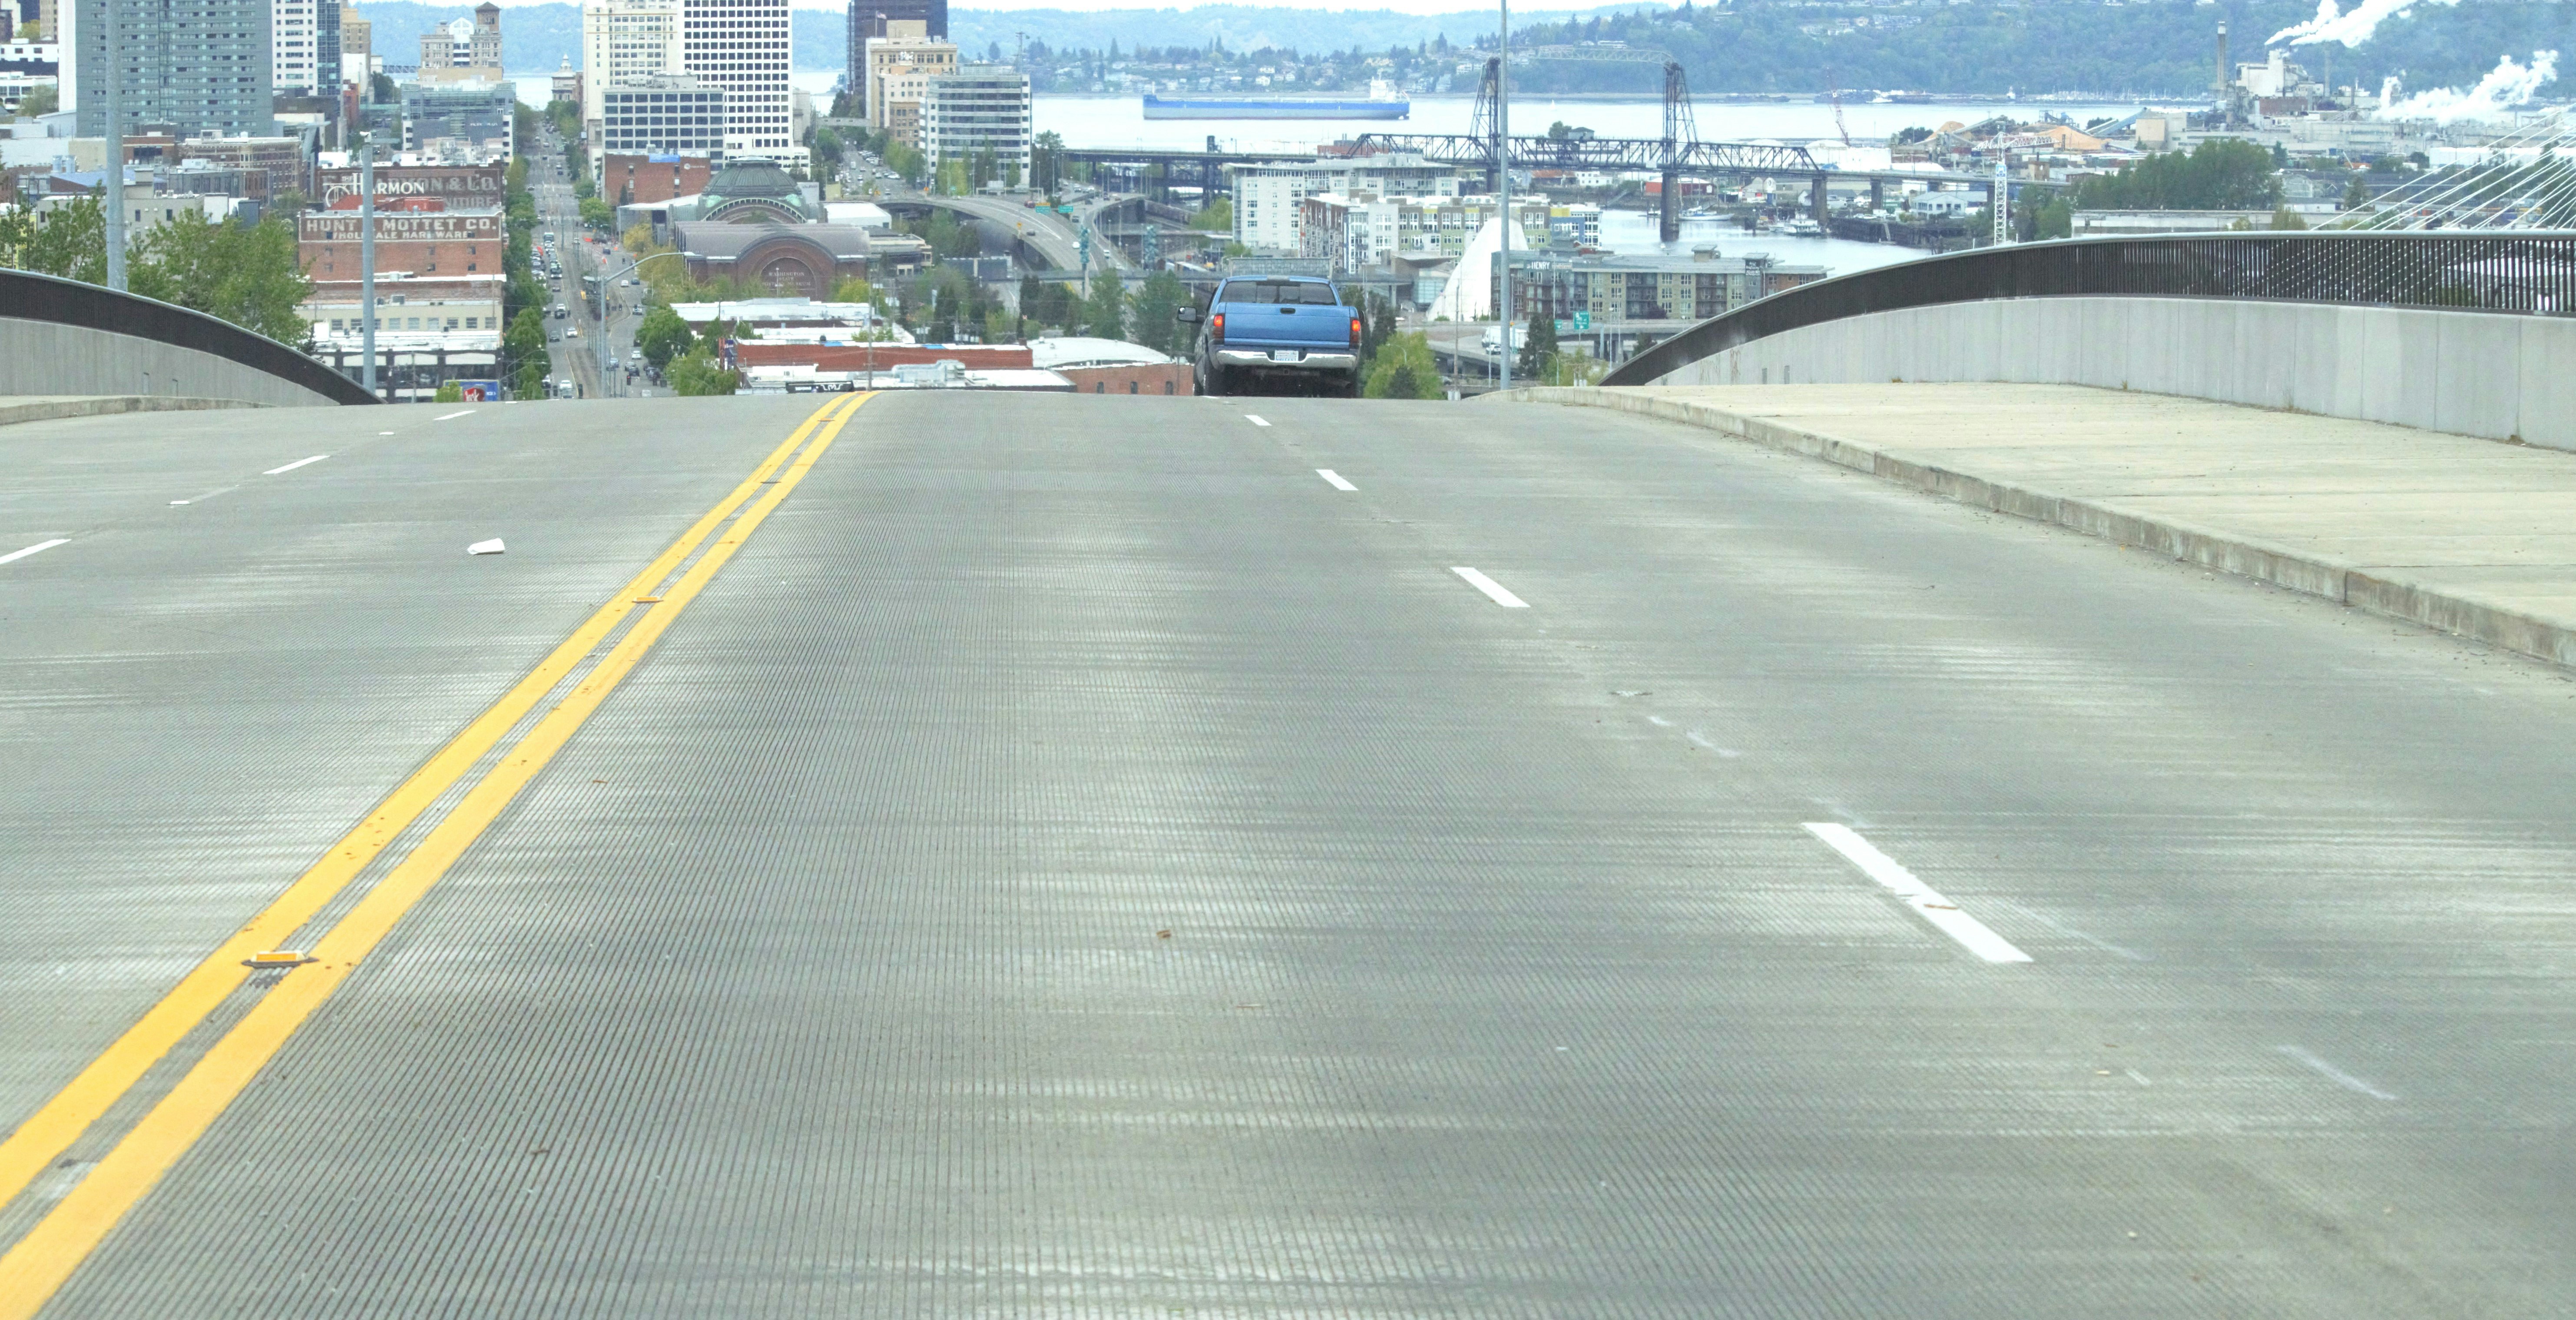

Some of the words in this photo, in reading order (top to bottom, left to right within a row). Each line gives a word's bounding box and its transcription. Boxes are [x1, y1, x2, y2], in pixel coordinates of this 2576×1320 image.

[352, 173, 424, 195] HRMON
[306, 220, 357, 232] HUNT
[382, 219, 457, 231] MOTTET
[466, 219, 497, 229] CO.
